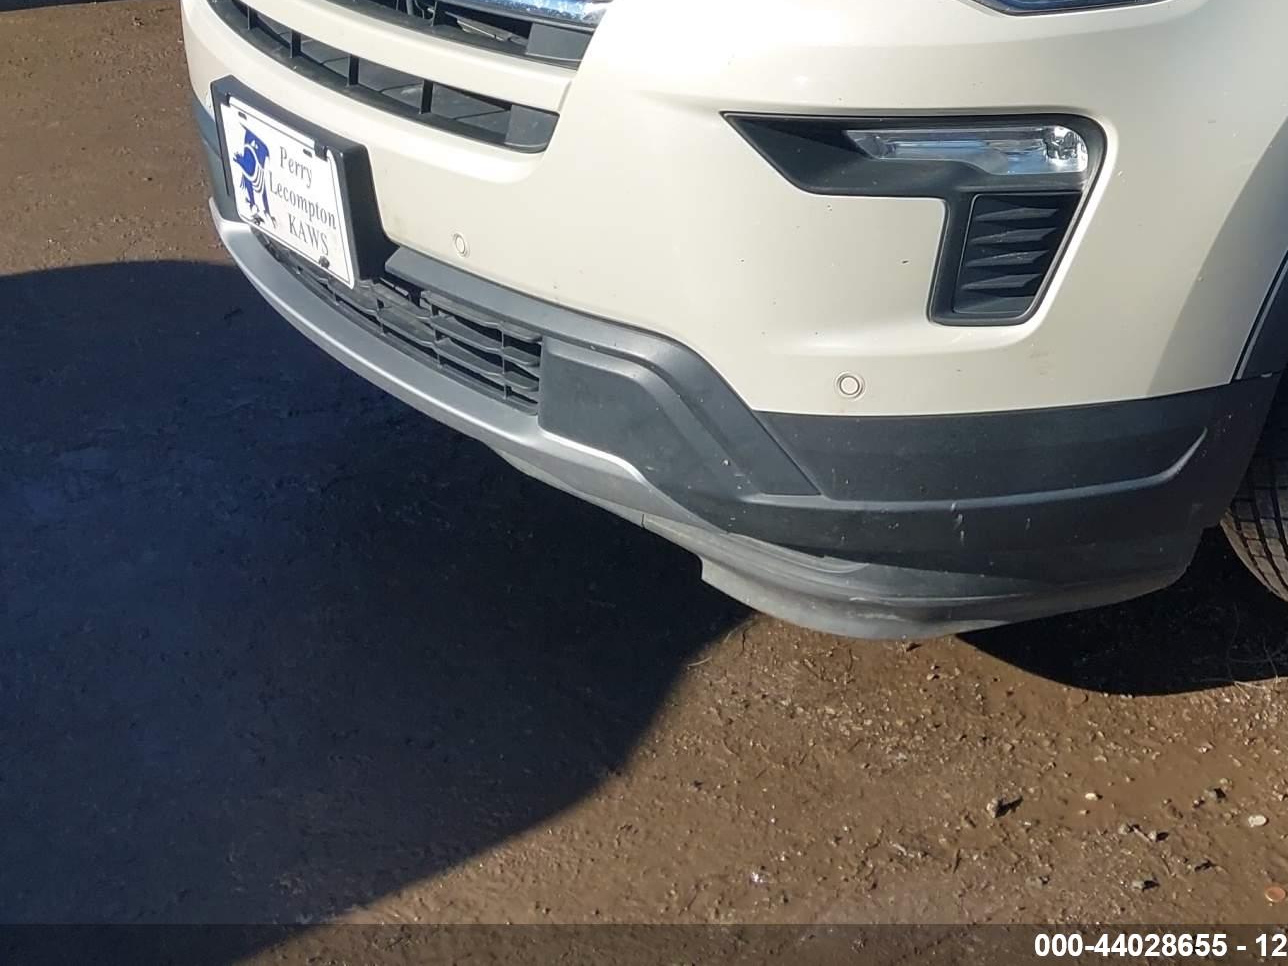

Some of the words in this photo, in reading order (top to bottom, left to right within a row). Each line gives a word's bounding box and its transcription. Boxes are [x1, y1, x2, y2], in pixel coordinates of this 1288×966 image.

[279, 145, 313, 189] Perry
[269, 171, 337, 230] Lecompton
[288, 213, 330, 257] KAWS
